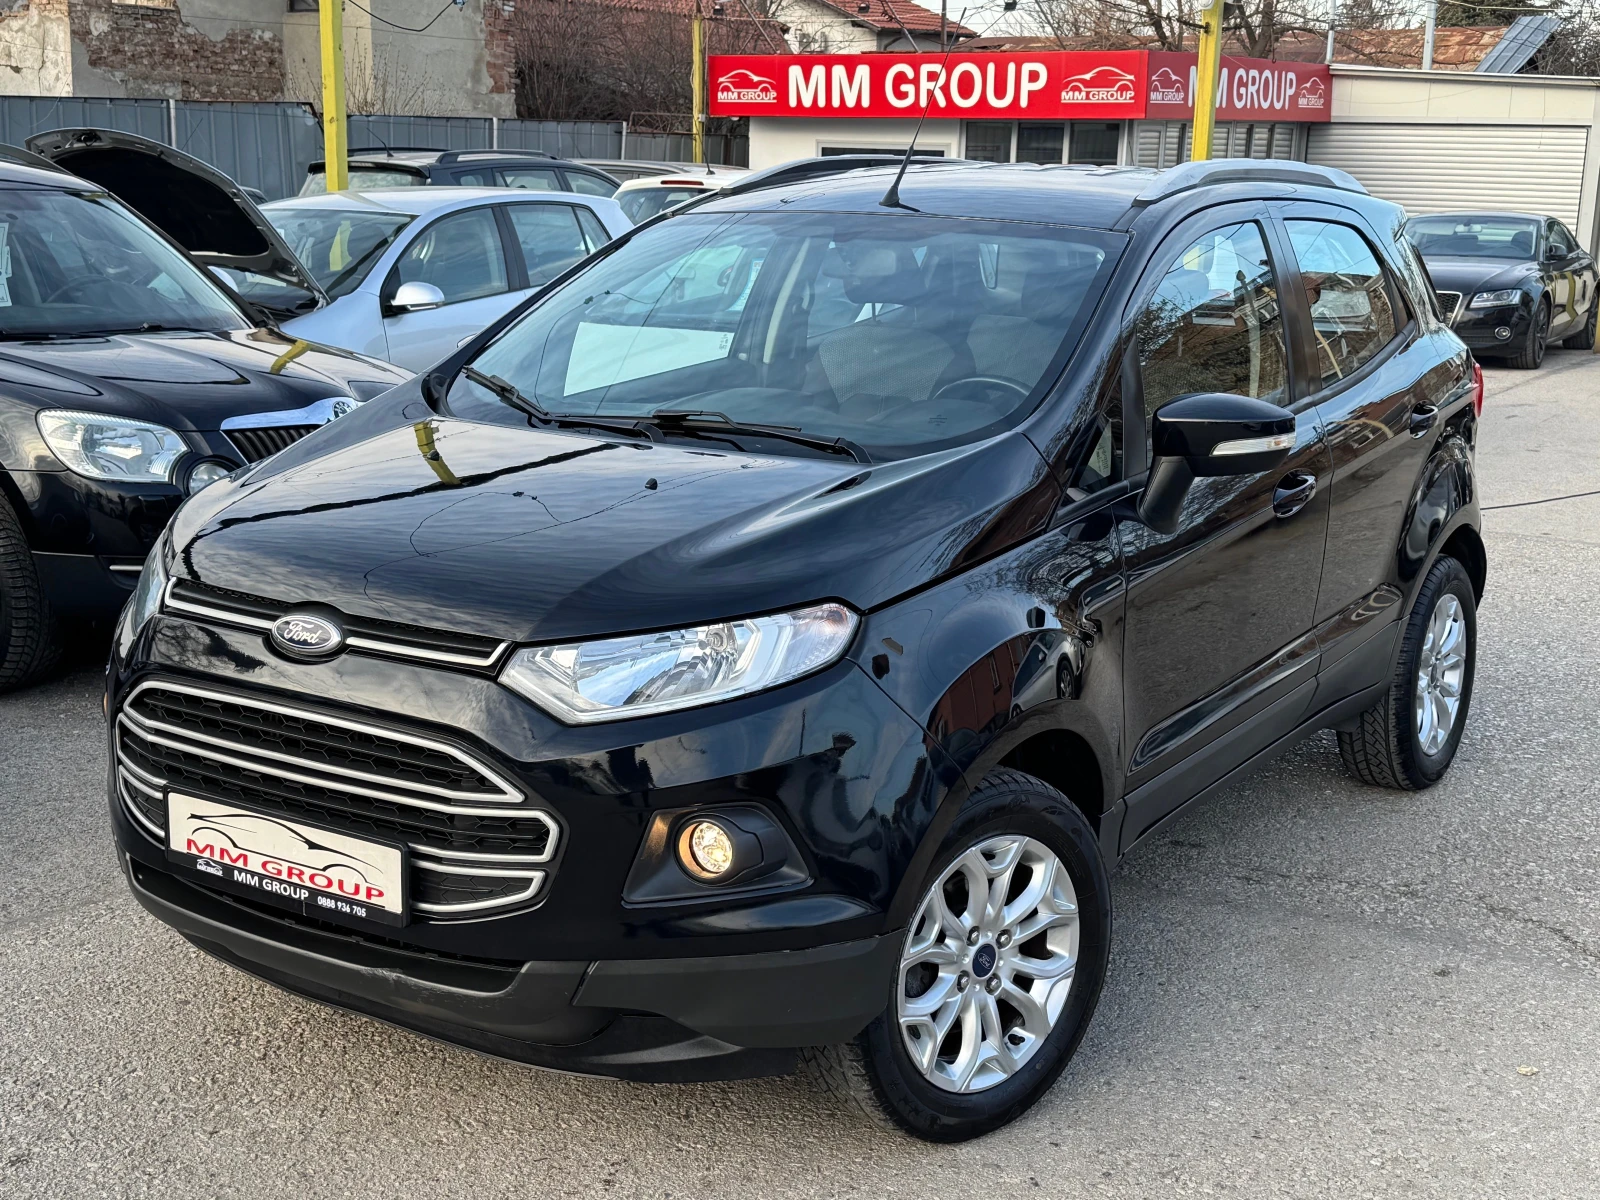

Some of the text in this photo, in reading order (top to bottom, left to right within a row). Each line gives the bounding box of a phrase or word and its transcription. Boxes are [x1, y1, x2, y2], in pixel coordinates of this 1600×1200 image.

[717, 91, 777, 101] MM GROUP
[787, 61, 1048, 109] MM GROUP
[1060, 91, 1135, 101] MM GROUP
[1150, 91, 1185, 101] MM GROUP
[1232, 67, 1297, 111] GROUP
[284, 621, 322, 644] Ford
[187, 838, 384, 900] MM GROUP
[233, 869, 259, 888] MM
[262, 879, 309, 900] GROUP
[317, 896, 367, 918] 0888 936 705
